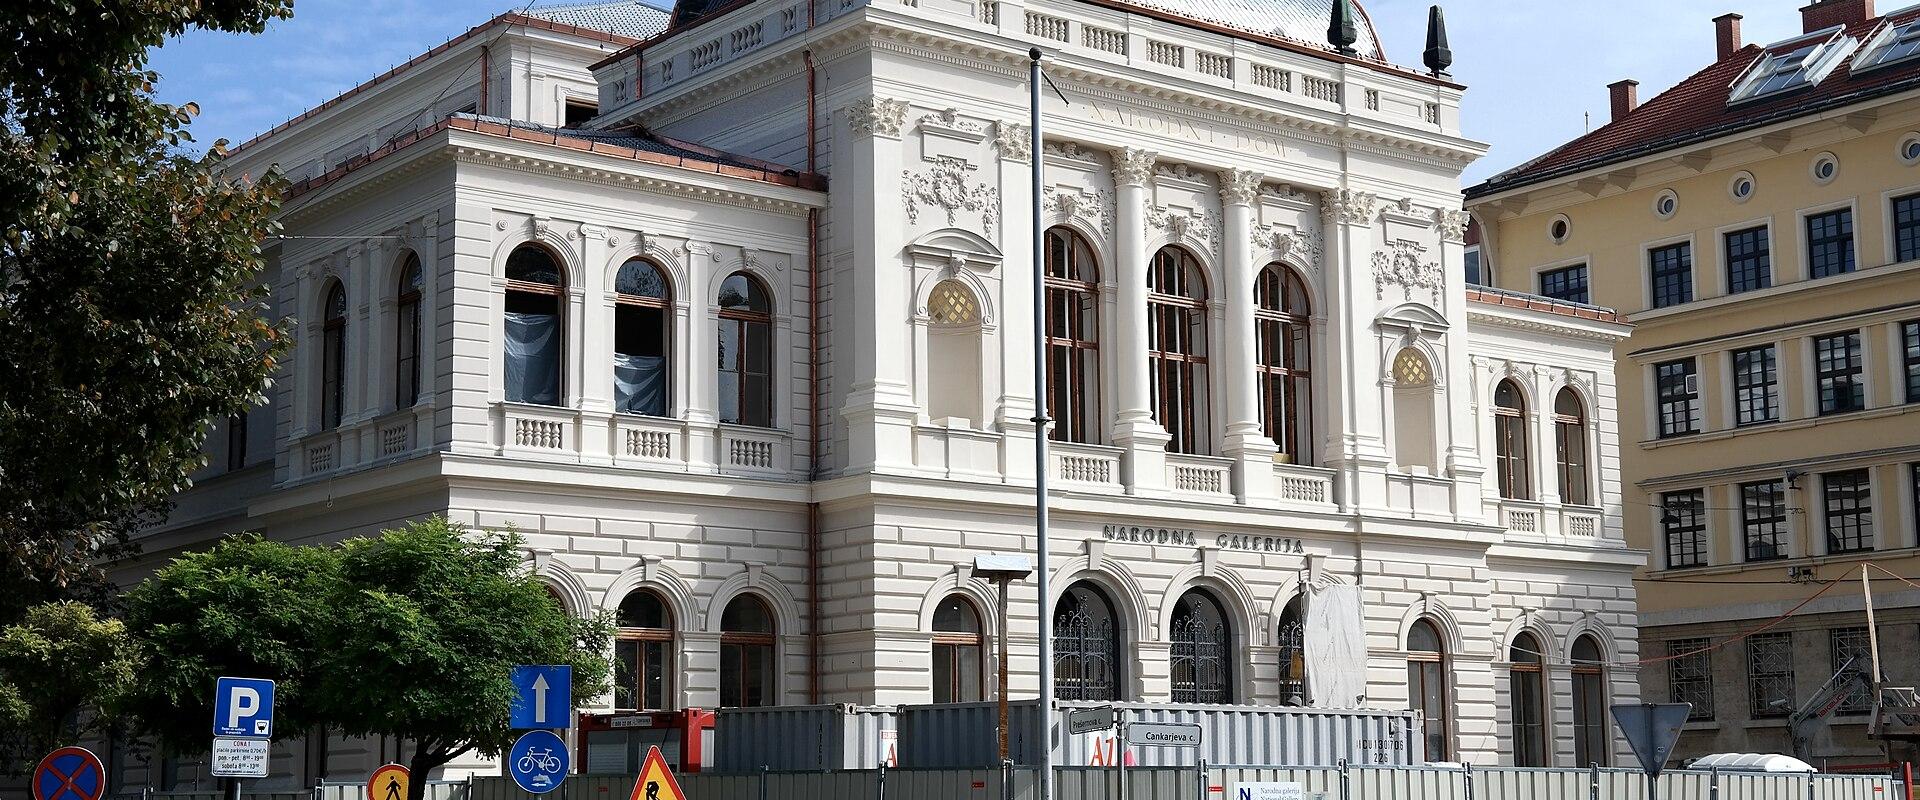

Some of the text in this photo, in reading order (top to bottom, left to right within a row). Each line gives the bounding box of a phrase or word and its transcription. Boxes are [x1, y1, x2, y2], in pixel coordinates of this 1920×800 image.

[1091, 101, 1214, 143] NARODNI
[1103, 524, 1305, 554] NARODNA GALERIJA
[229, 687, 260, 728] P
[1145, 731, 1196, 742] Cankarjeva c.
